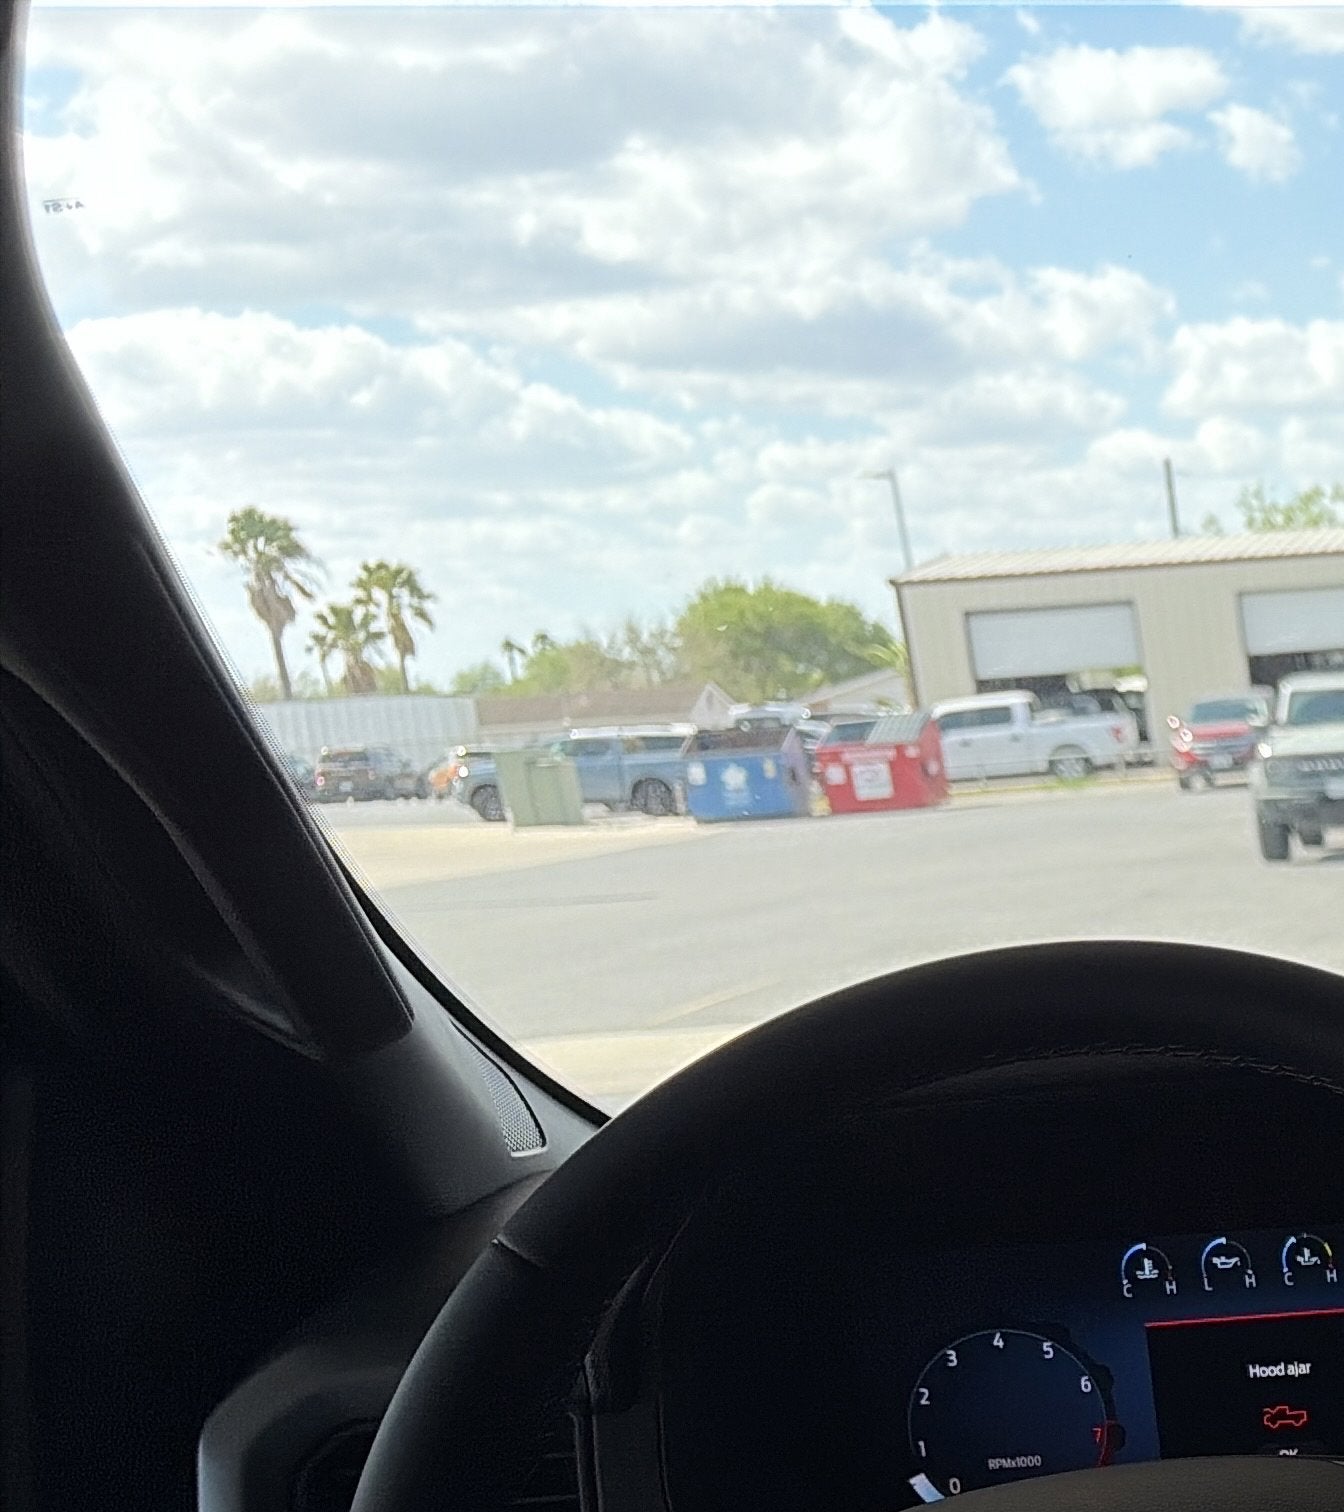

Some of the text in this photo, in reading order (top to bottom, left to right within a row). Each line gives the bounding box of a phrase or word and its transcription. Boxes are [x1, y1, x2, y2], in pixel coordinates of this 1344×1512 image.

[1203, 1277, 1213, 1291] L
[1245, 1275, 1257, 1289] H
[1284, 1272, 1294, 1286] C
[1326, 1269, 1338, 1283] H
[1165, 1281, 1177, 1295] H
[993, 1332, 1004, 1349] 4
[946, 1350, 958, 1367] 3
[1042, 1342, 1054, 1359] 5
[1248, 1361, 1312, 1378] Hood ajar
[1080, 1375, 1092, 1393] 6
[918, 1388, 930, 1405] 2
[918, 1441, 927, 1457] 1
[988, 1455, 1042, 1470] RPMx1000
[950, 1478, 961, 1494] 0
